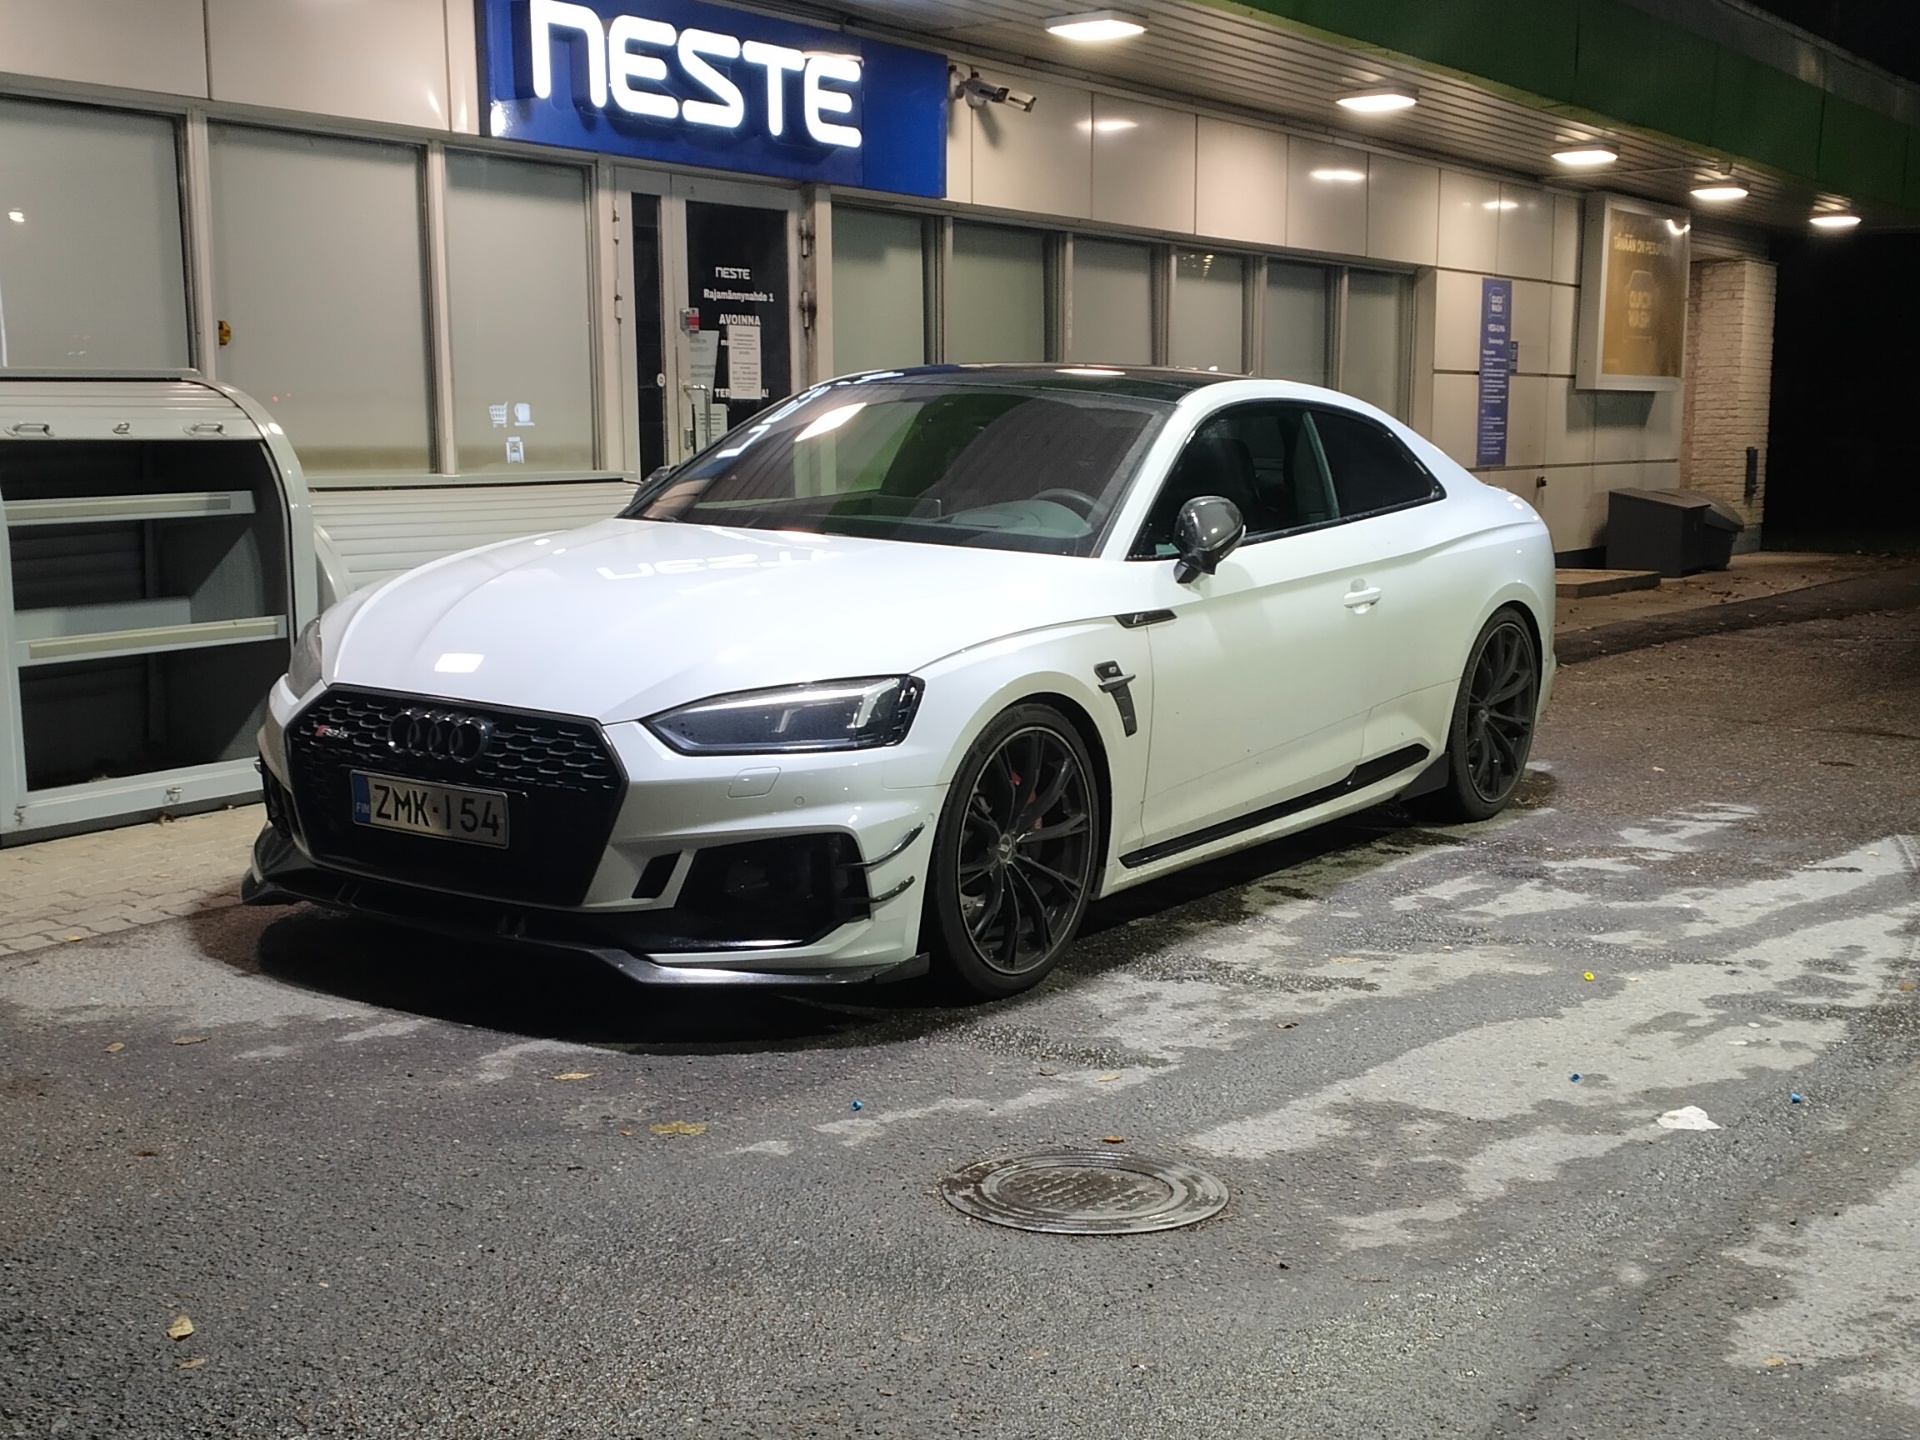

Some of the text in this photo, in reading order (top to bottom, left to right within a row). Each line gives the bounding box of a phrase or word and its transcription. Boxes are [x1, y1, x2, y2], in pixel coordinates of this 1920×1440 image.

[530, 0, 862, 148] NESTE
[715, 266, 751, 280] NESTE
[768, 293, 775, 302] 1
[719, 313, 761, 326] AVOINNA
[355, 801, 370, 813] FIN
[373, 784, 500, 837] ZMK-154
